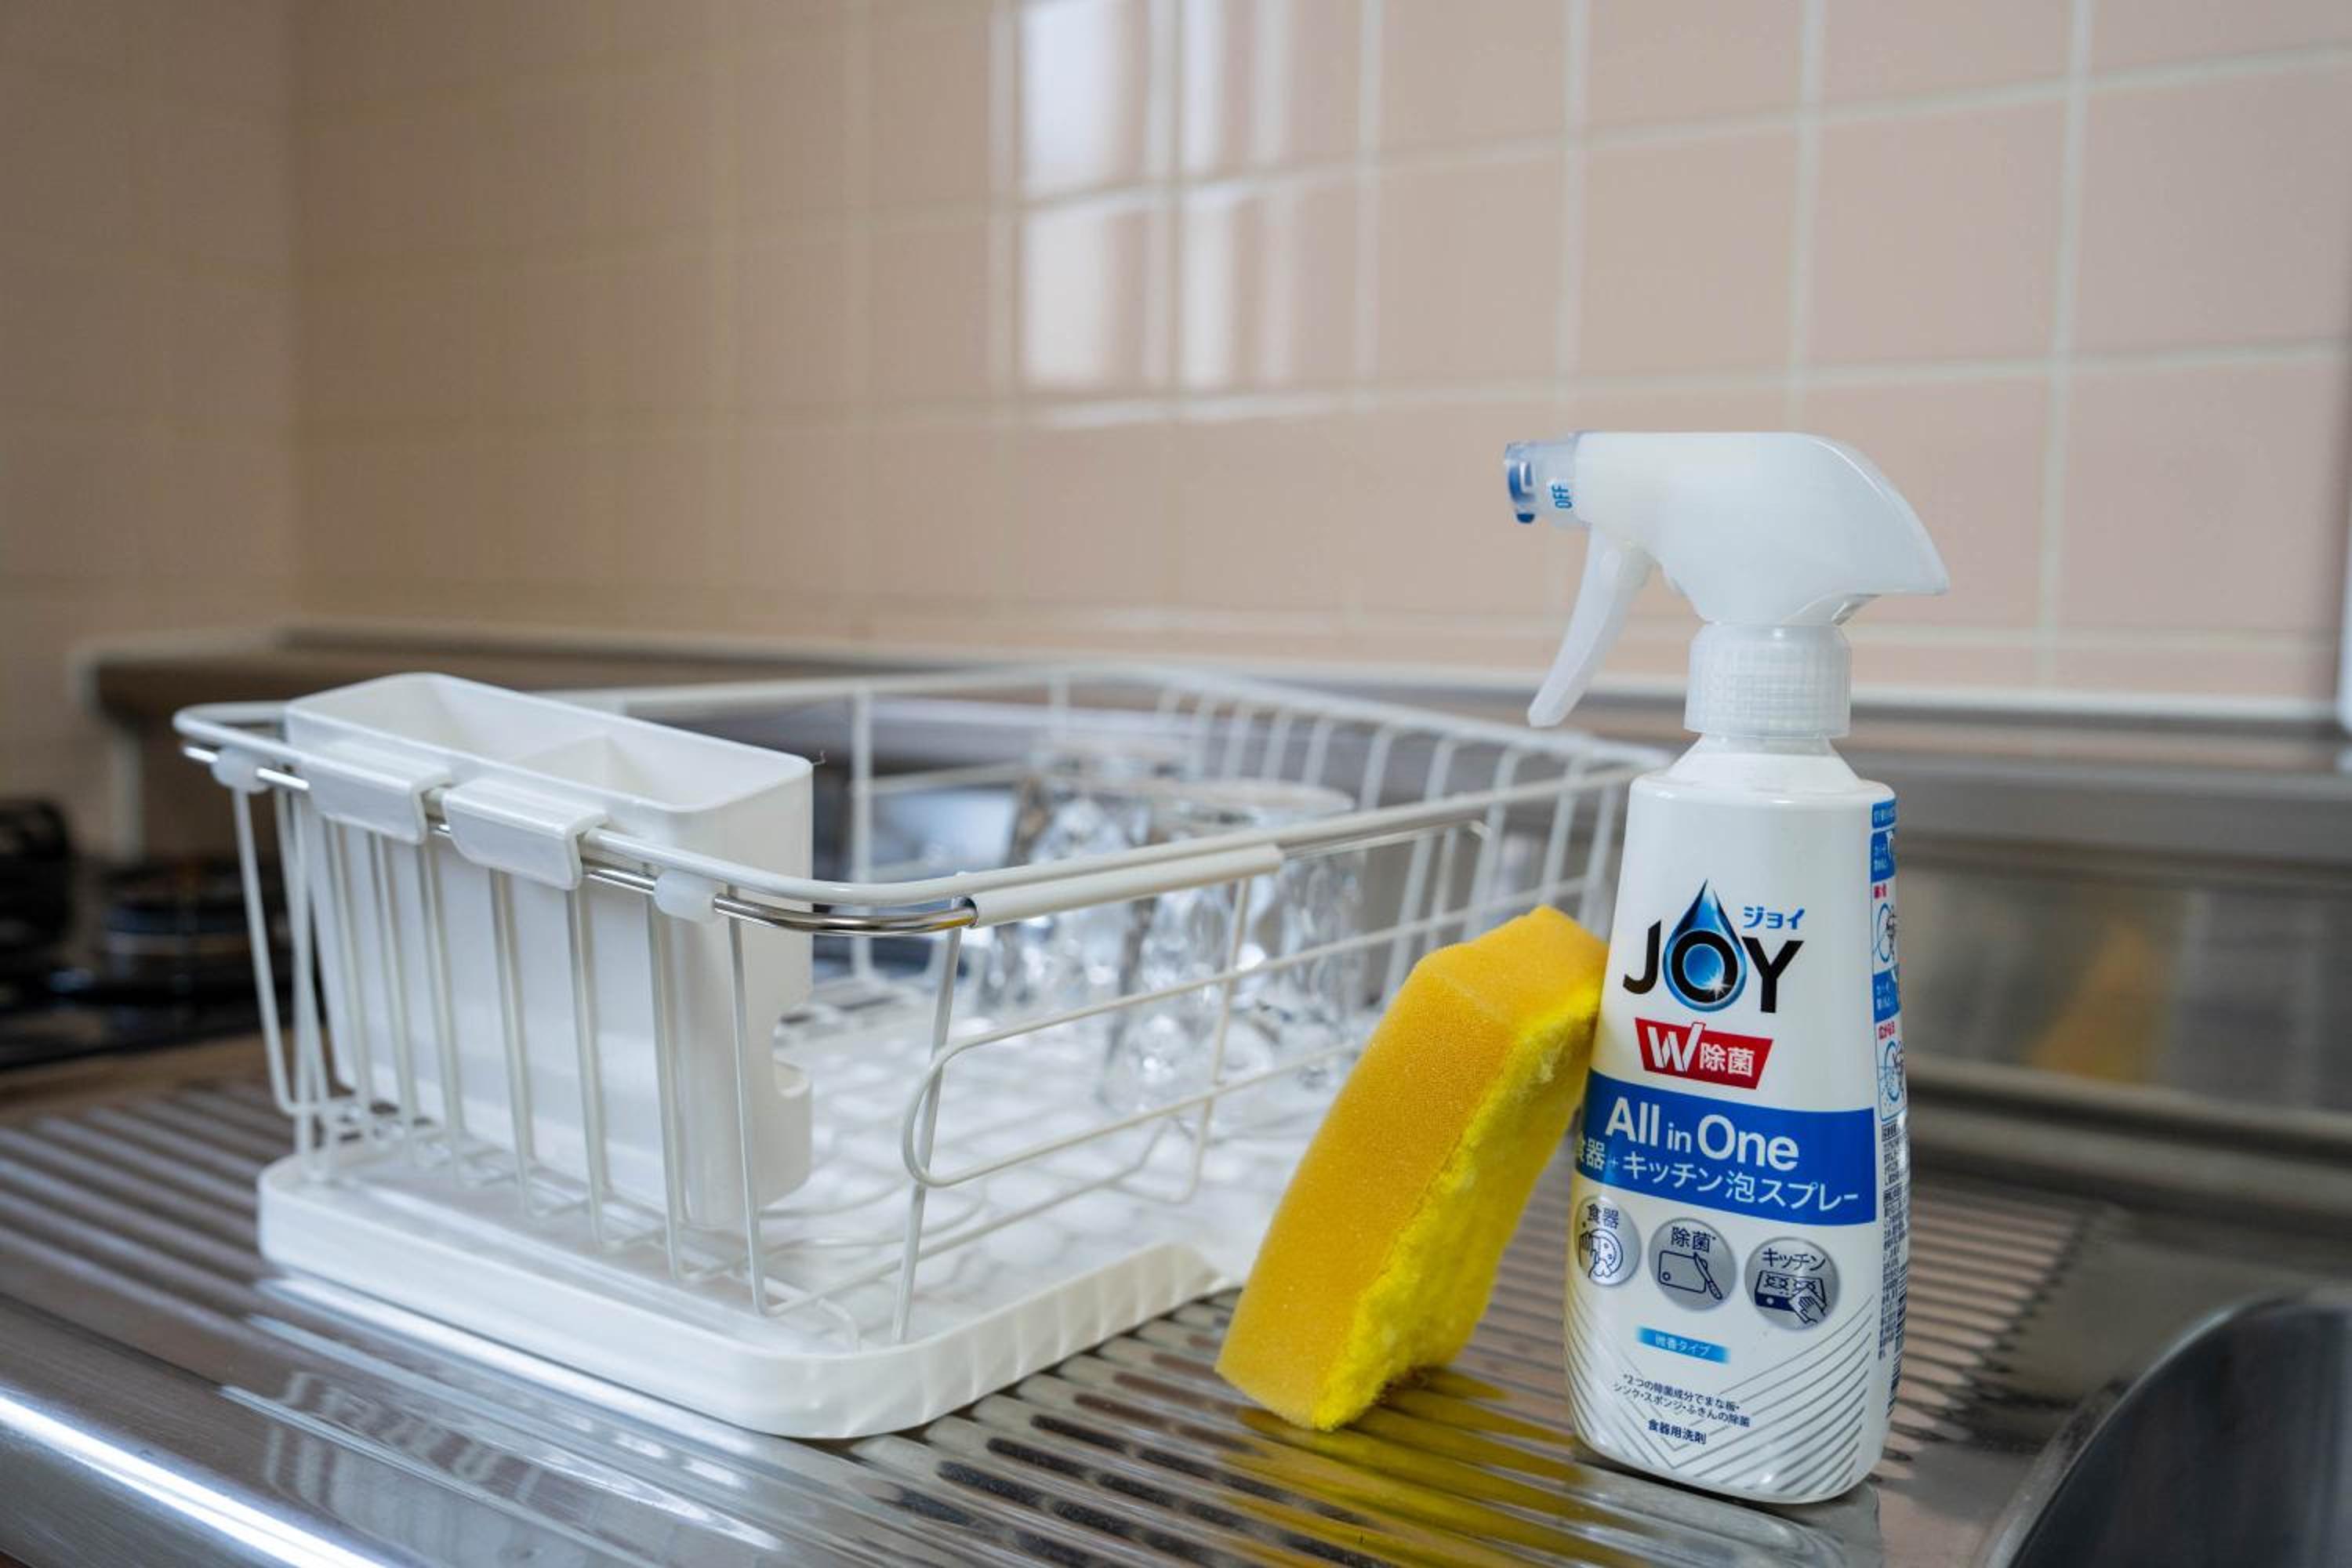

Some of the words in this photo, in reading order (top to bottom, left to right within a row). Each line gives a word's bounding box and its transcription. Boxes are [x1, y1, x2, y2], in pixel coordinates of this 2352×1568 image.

[1551, 483, 1573, 509] OFF
[1743, 906, 1805, 931] ジョイ
[1622, 919, 1804, 1014] JOY
[1605, 1097, 1660, 1147] All
[1668, 1123, 1692, 1153] in
[1697, 1114, 1800, 1171] One
[1587, 1203, 1619, 1230] 食器
[1762, 1247, 1826, 1271] キッチン
[1648, 1418, 1708, 1444] 食器用洗剤
